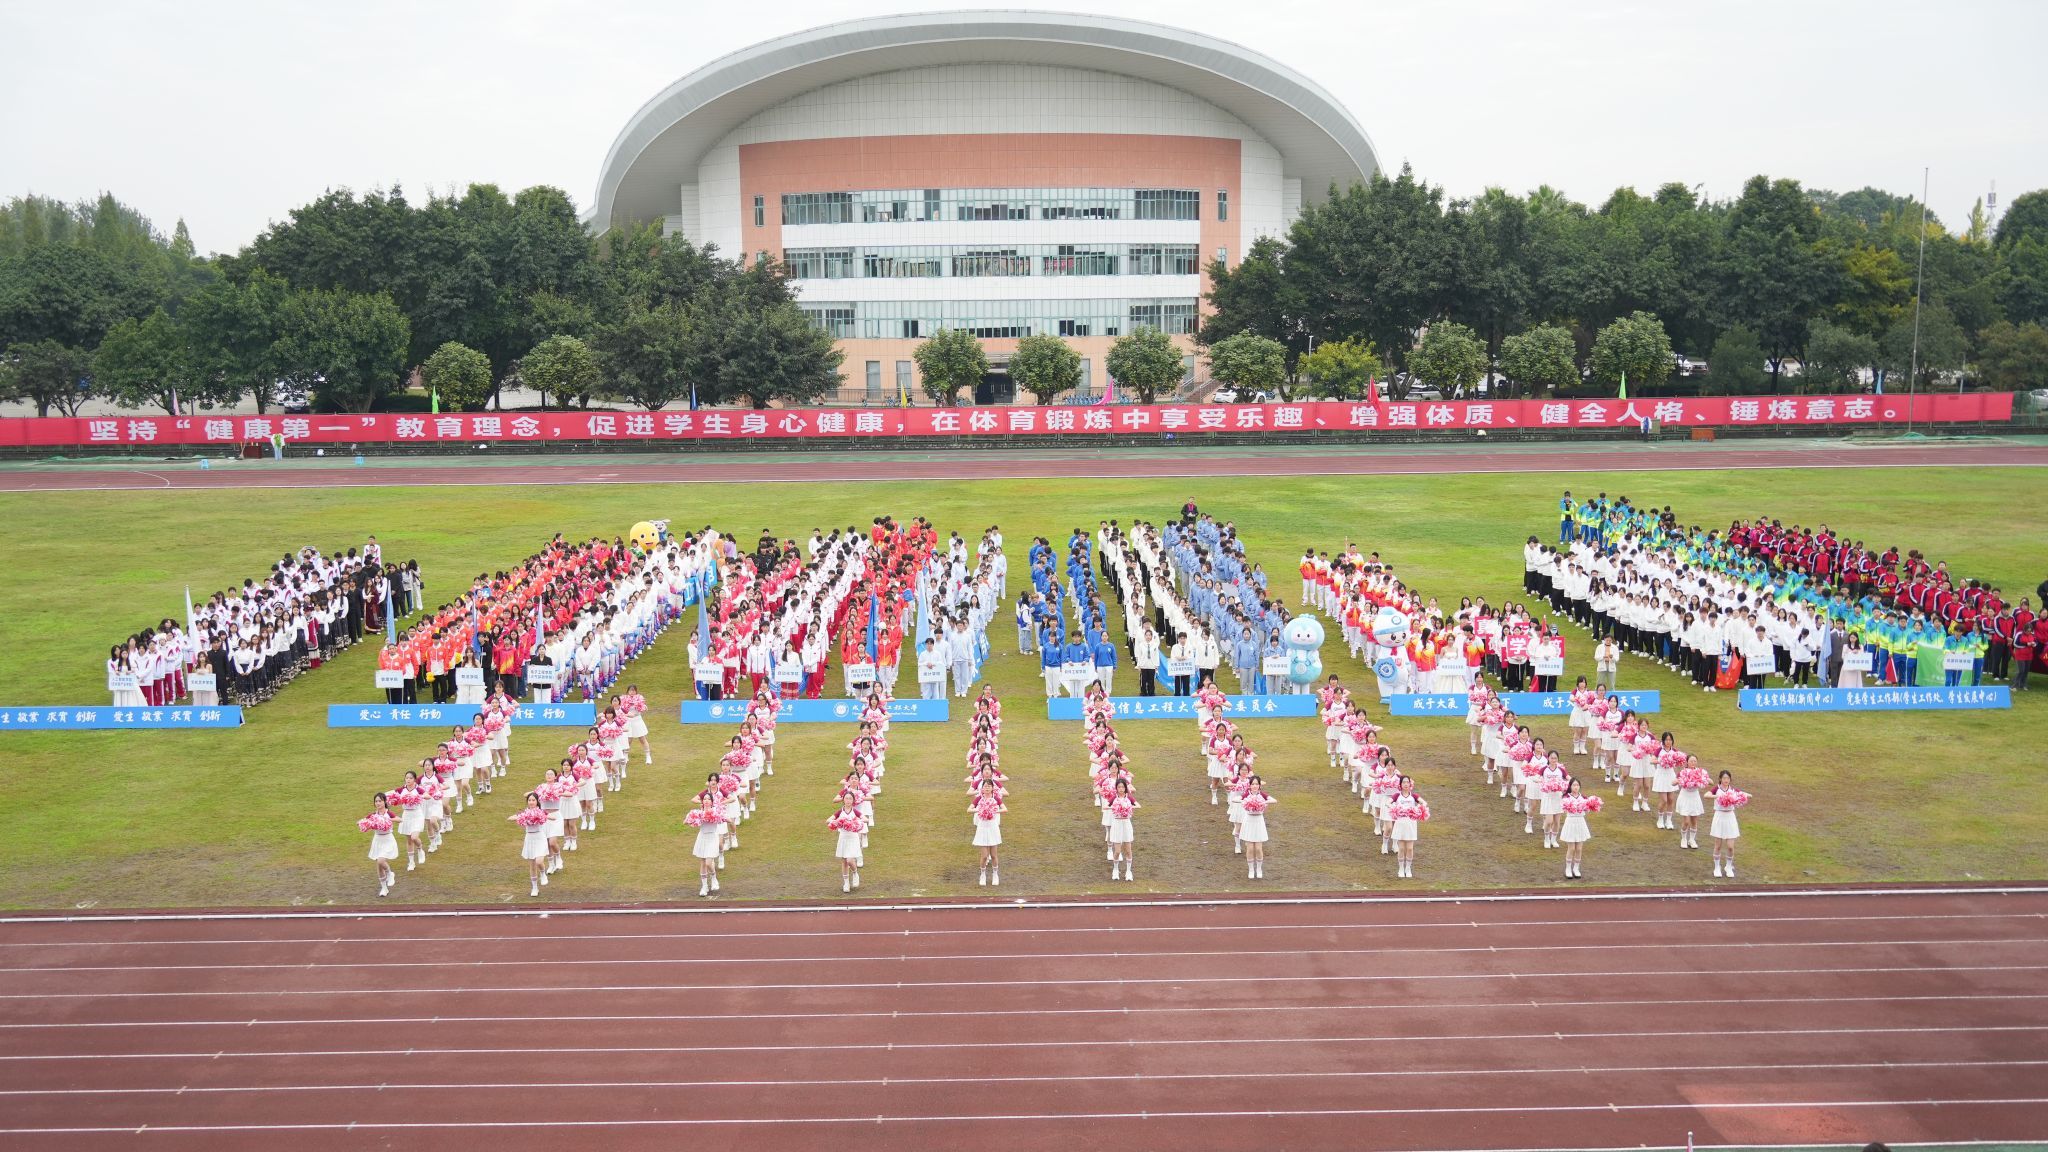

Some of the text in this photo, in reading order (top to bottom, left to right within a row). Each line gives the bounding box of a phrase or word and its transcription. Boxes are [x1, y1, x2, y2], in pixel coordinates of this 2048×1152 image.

[1509, 637, 1527, 654] 学
[1543, 697, 1575, 709] 成于大
